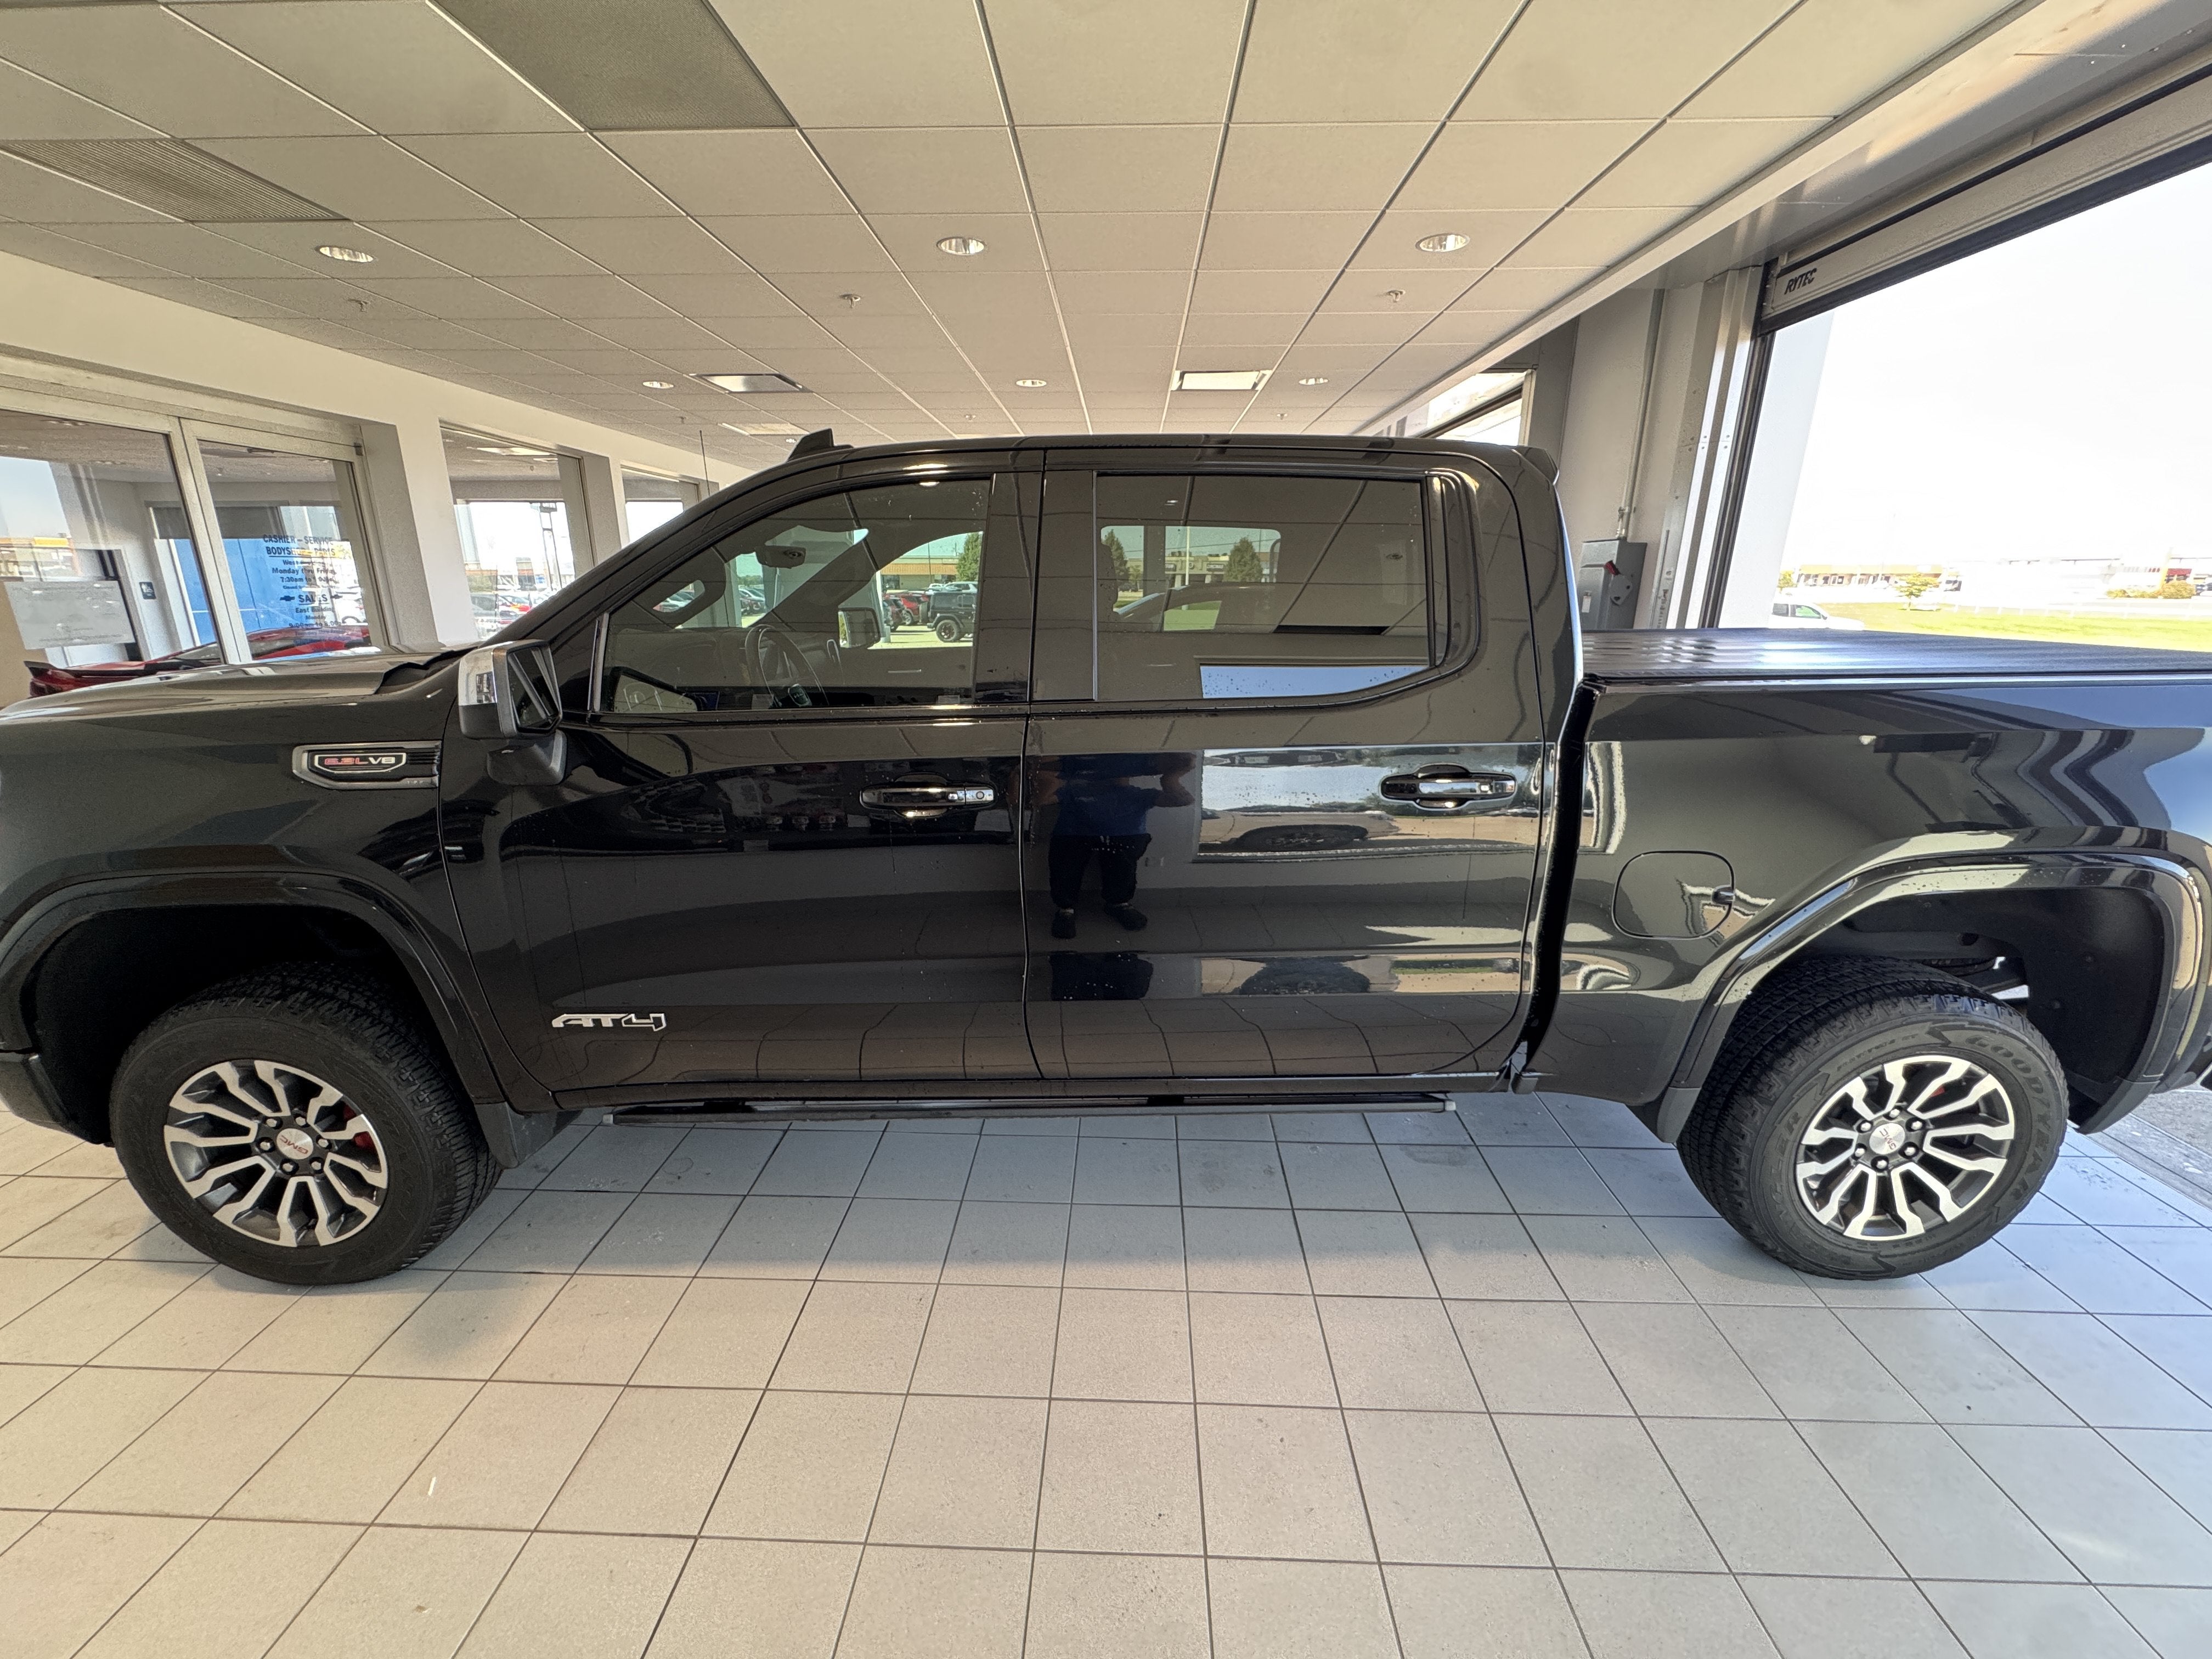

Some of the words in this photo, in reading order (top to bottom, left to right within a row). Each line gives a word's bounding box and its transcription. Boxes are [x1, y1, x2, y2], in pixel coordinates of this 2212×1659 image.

[1784, 268, 1817, 295] RYTEC
[263, 534, 296, 544] CASHIER
[551, 1013, 668, 1032] AT4
[1965, 1035, 2052, 1201] GOODYEAR
[279, 1134, 309, 1155] GMC
[1878, 1127, 1897, 1150] GMC
